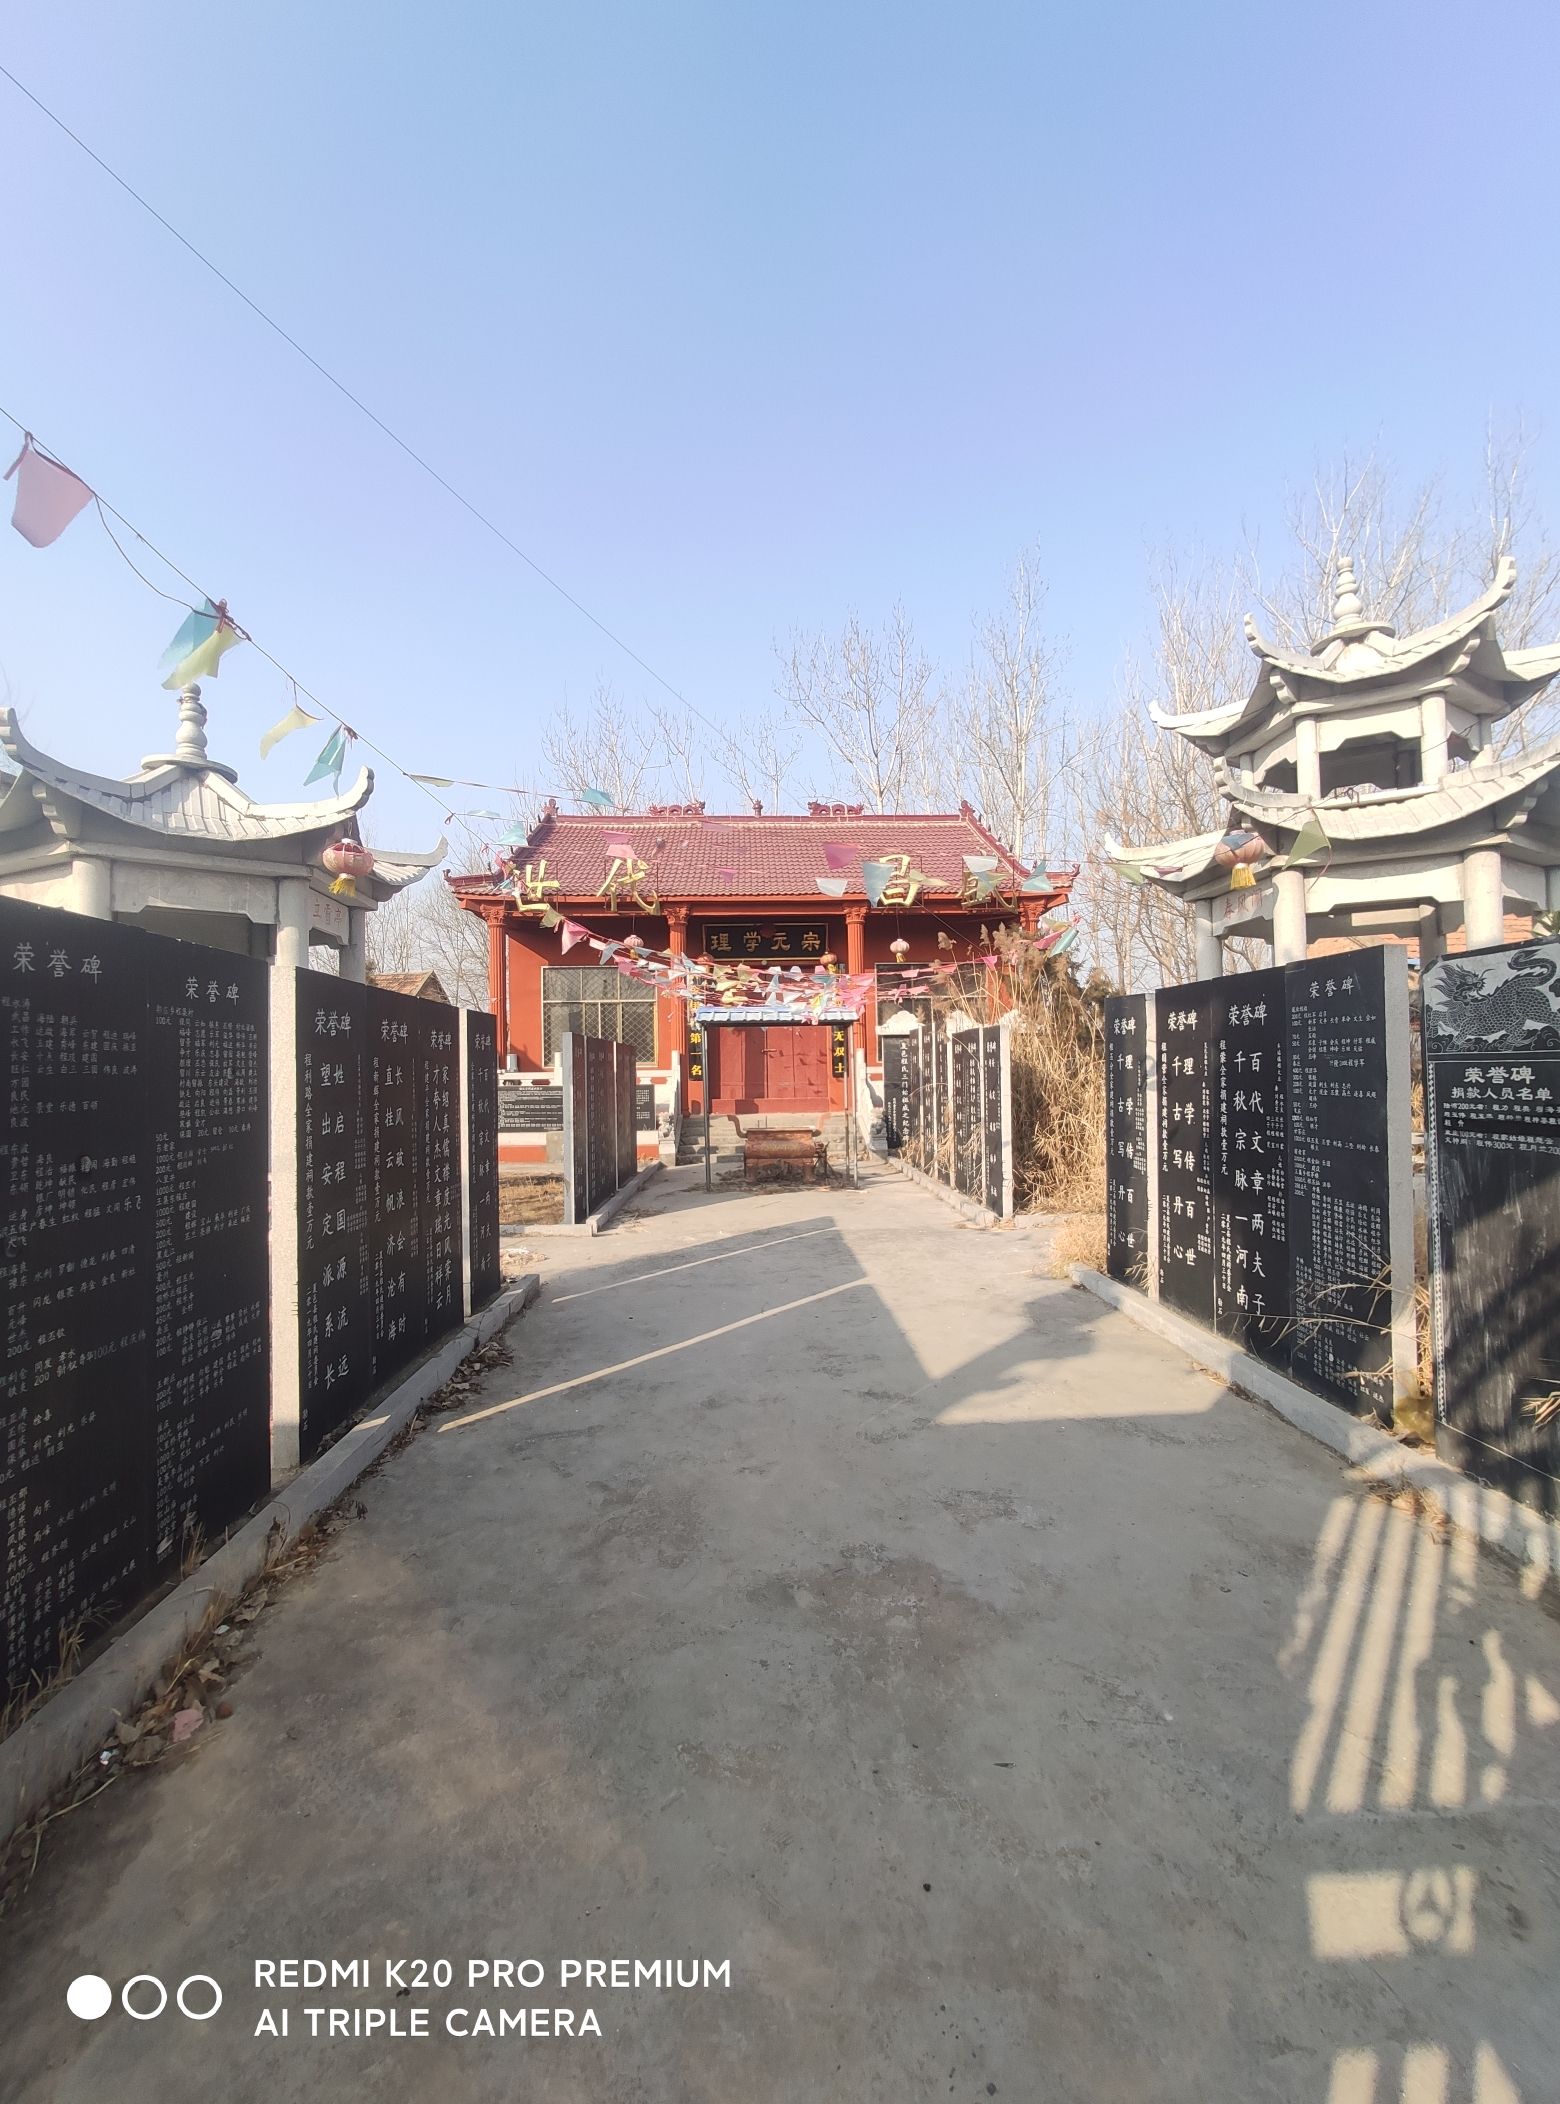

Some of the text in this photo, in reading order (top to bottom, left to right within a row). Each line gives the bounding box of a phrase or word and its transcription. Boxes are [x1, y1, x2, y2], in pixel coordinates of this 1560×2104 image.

[13, 941, 103, 984] 荣誉碑
[186, 976, 239, 1006] 荣誉碑
[1309, 976, 1354, 999] 荣誉碑
[315, 1008, 352, 1039] 荣誉碑
[1114, 1016, 1136, 1034] 荣誉碑
[1167, 1009, 1198, 1032] 荣誉碑
[1228, 1001, 1268, 1027] 荣誉碑
[381, 1018, 408, 1045] 荣誉碑
[430, 1030, 452, 1051] 荣誉碑
[1463, 1065, 1535, 1084] 荣誉碑
[1451, 1087, 1553, 1100] 捐款人员名单
[1172, 1056, 1183, 1259] 千古写丹心
[1183, 1057, 1196, 1266] 理学传百世
[1233, 1050, 1248, 1310] 千秋宗脉一河南
[1249, 1051, 1265, 1316] 百代文章两夫子
